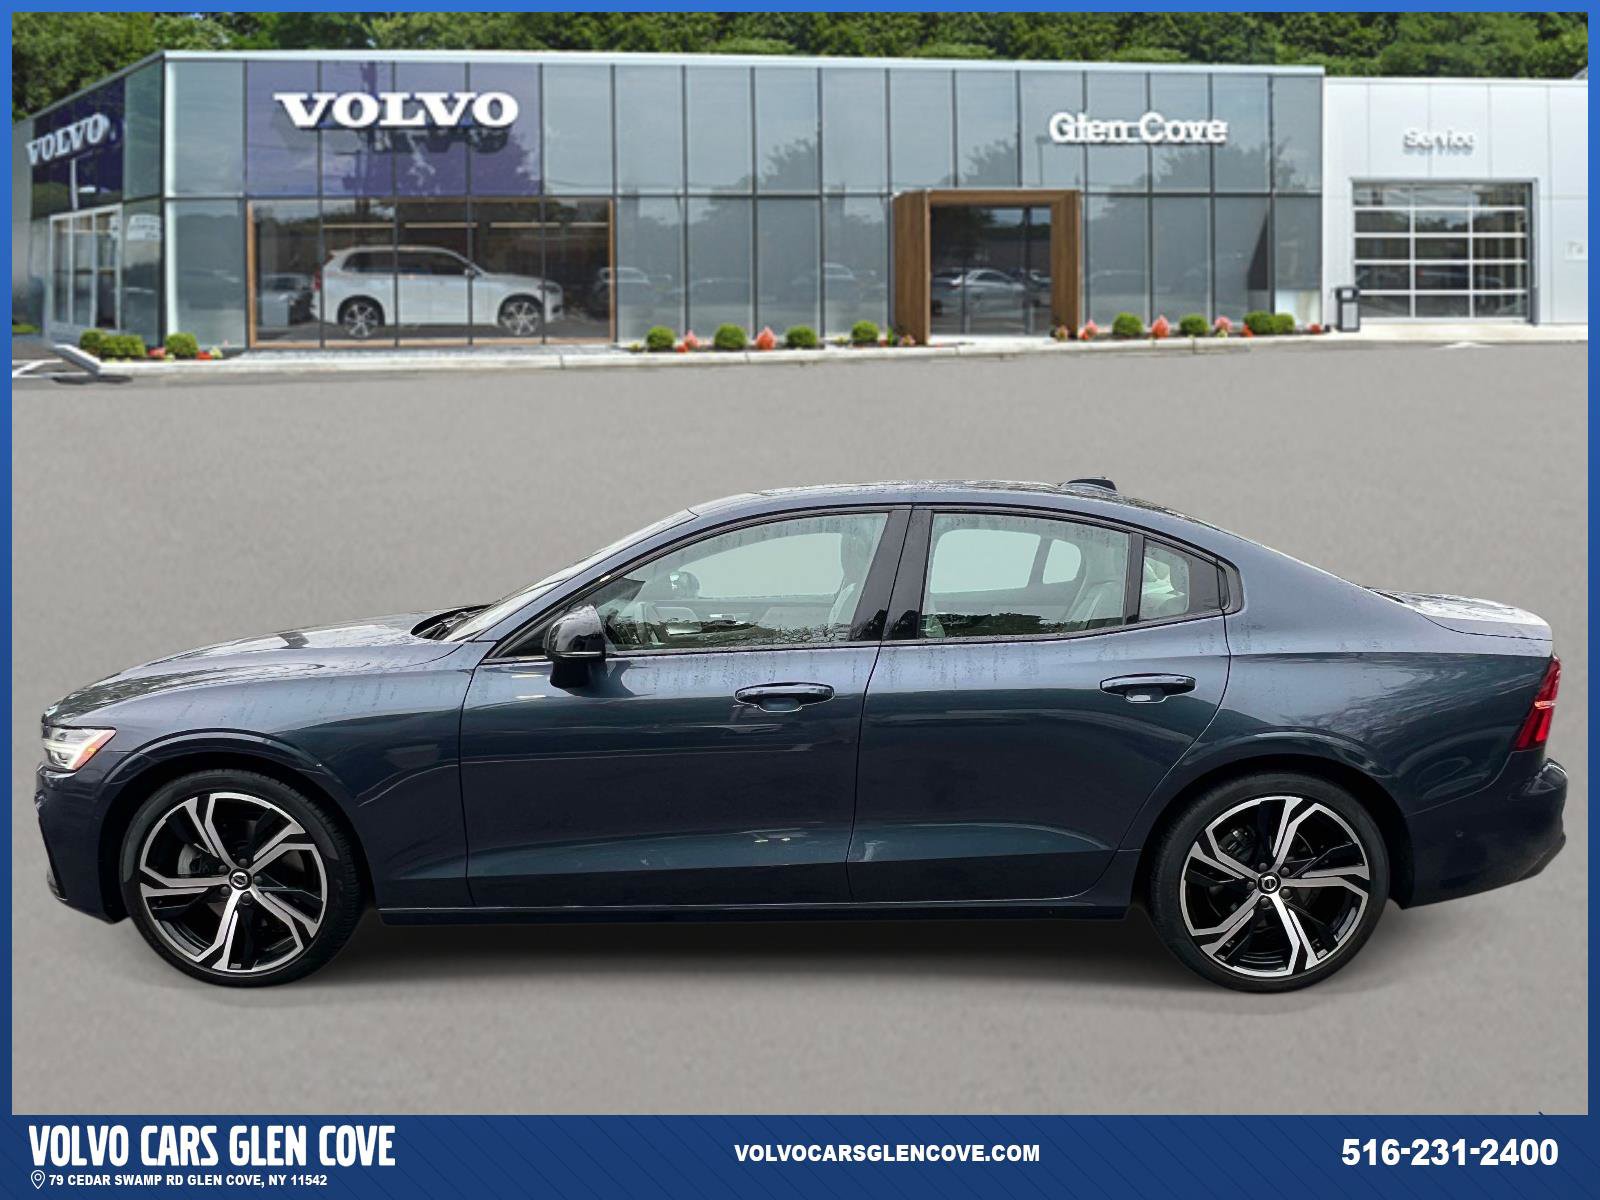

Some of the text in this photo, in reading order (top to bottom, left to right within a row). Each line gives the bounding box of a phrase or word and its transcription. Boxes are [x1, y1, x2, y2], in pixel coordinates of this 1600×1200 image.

[274, 92, 519, 127] VOLVO
[26, 113, 109, 165] VOLVO
[1049, 112, 1228, 143] Glen Cove
[1403, 127, 1475, 152] Service
